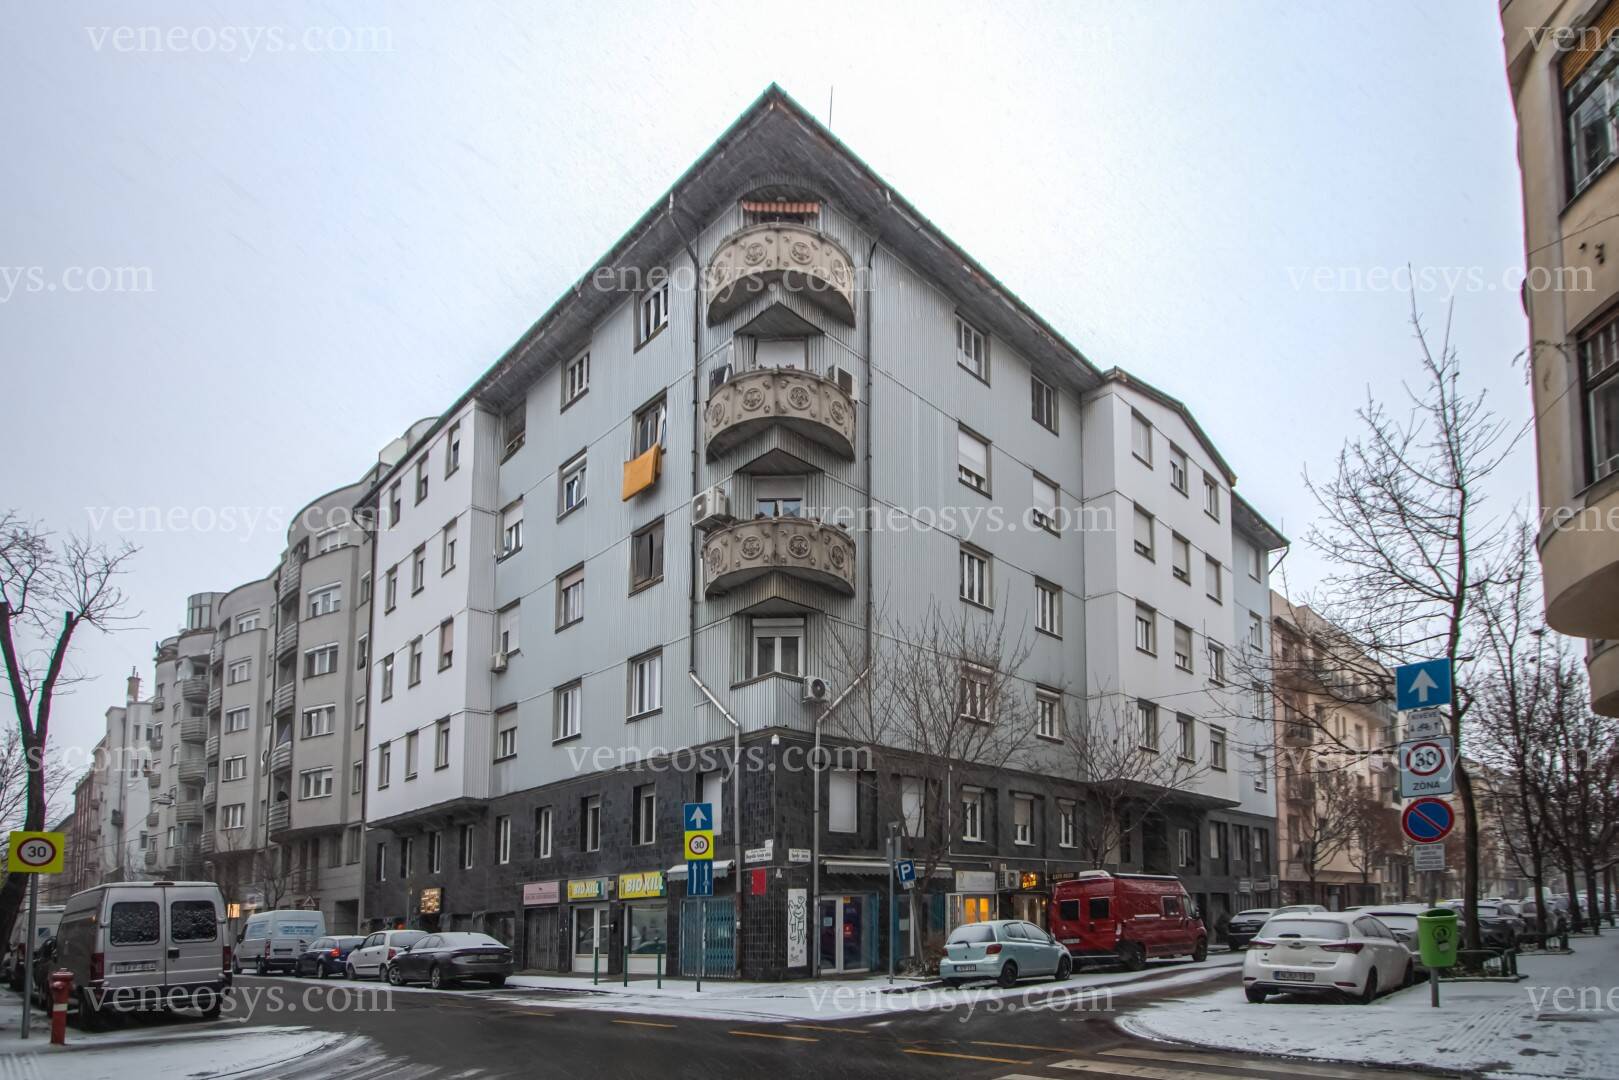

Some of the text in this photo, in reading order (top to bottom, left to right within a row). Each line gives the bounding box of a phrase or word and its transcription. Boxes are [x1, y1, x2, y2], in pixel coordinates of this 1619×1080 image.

[1415, 750, 1437, 768] 30
[27, 846, 47, 858] 30
[694, 840, 705, 850] 30
[900, 863, 911, 880] P
